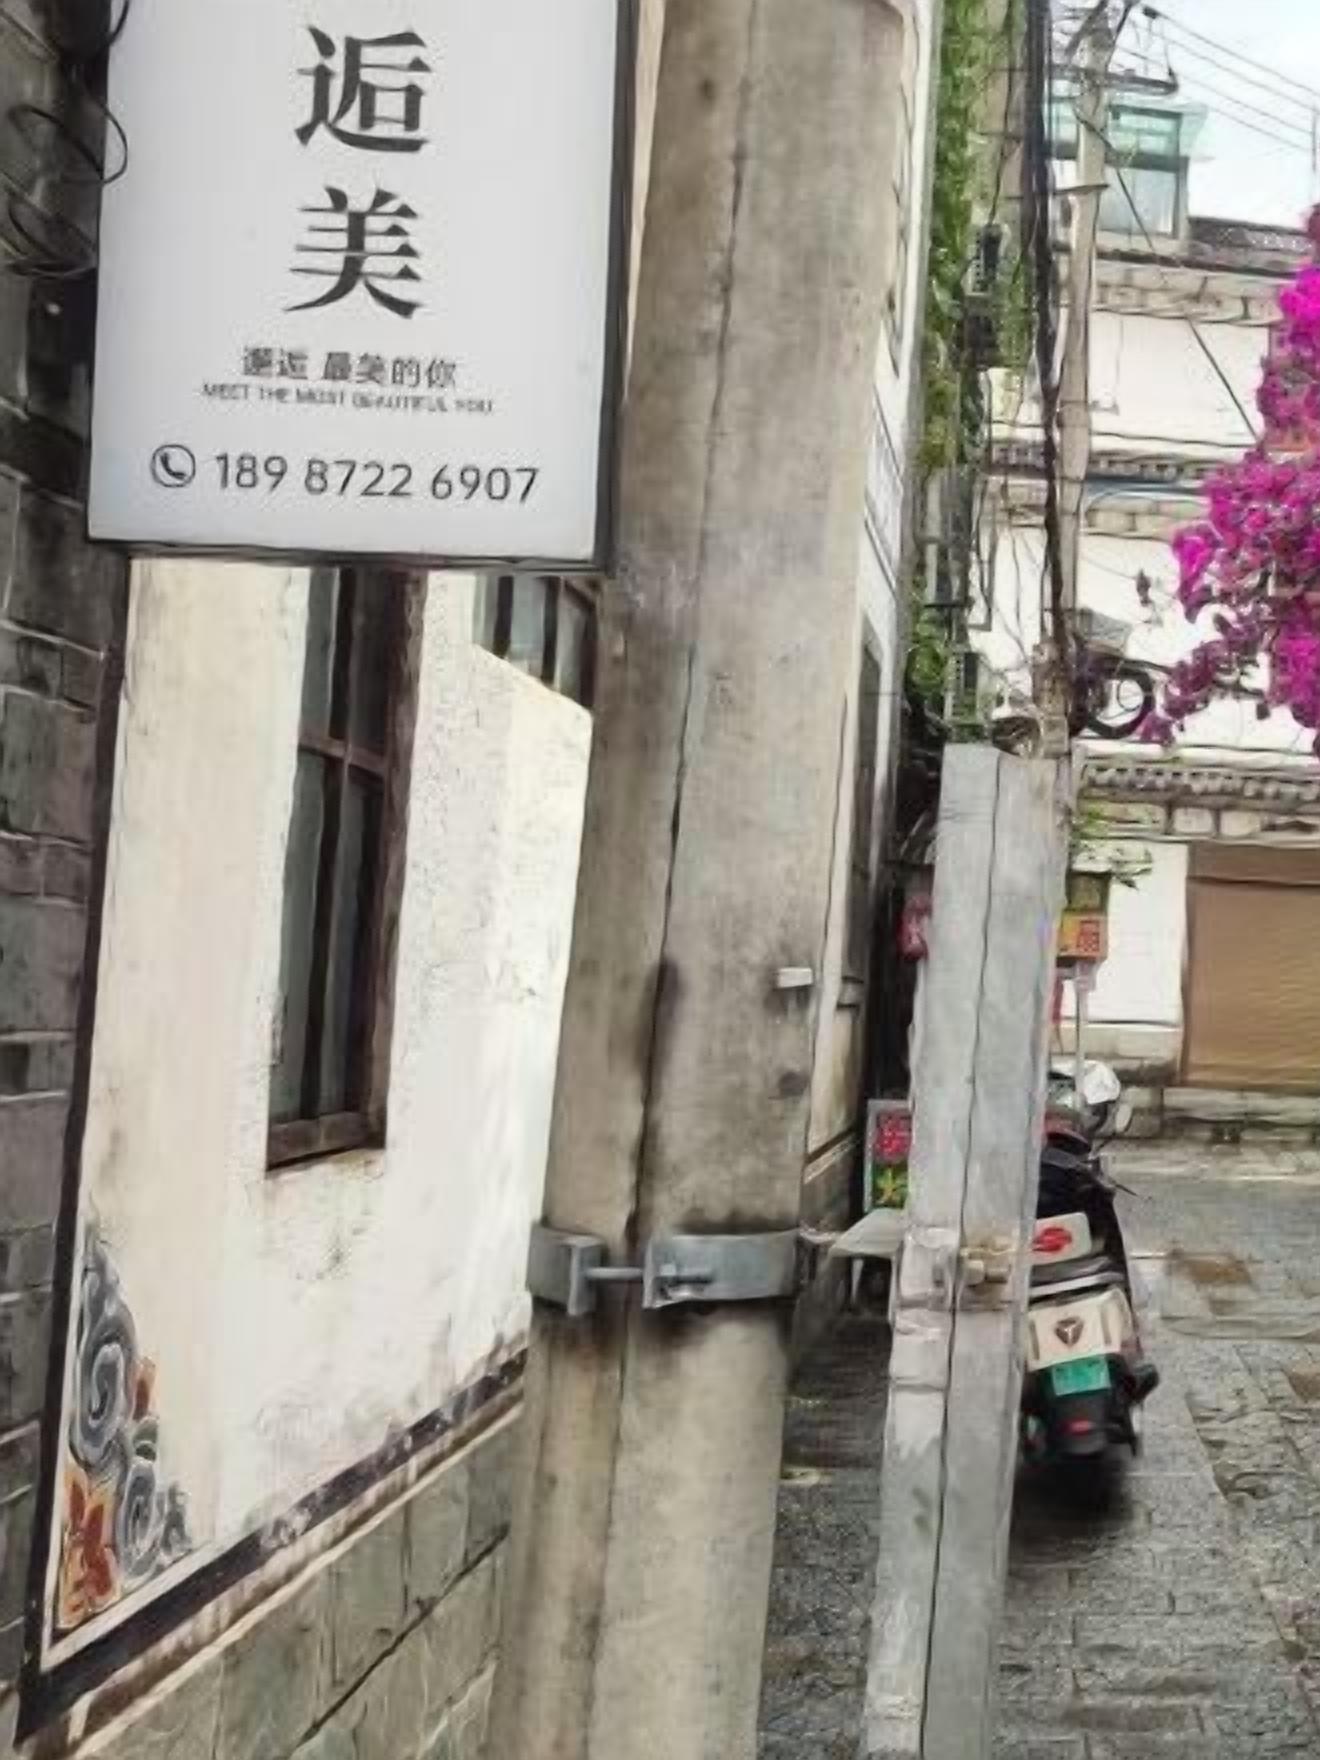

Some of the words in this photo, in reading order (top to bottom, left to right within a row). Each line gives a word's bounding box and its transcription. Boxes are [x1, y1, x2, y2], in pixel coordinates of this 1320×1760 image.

[287, 26, 434, 319] 逅美
[321, 350, 457, 389] 最美的你
[214, 453, 288, 491] 189
[303, 459, 413, 498] 8722
[430, 463, 540, 503] 6907
